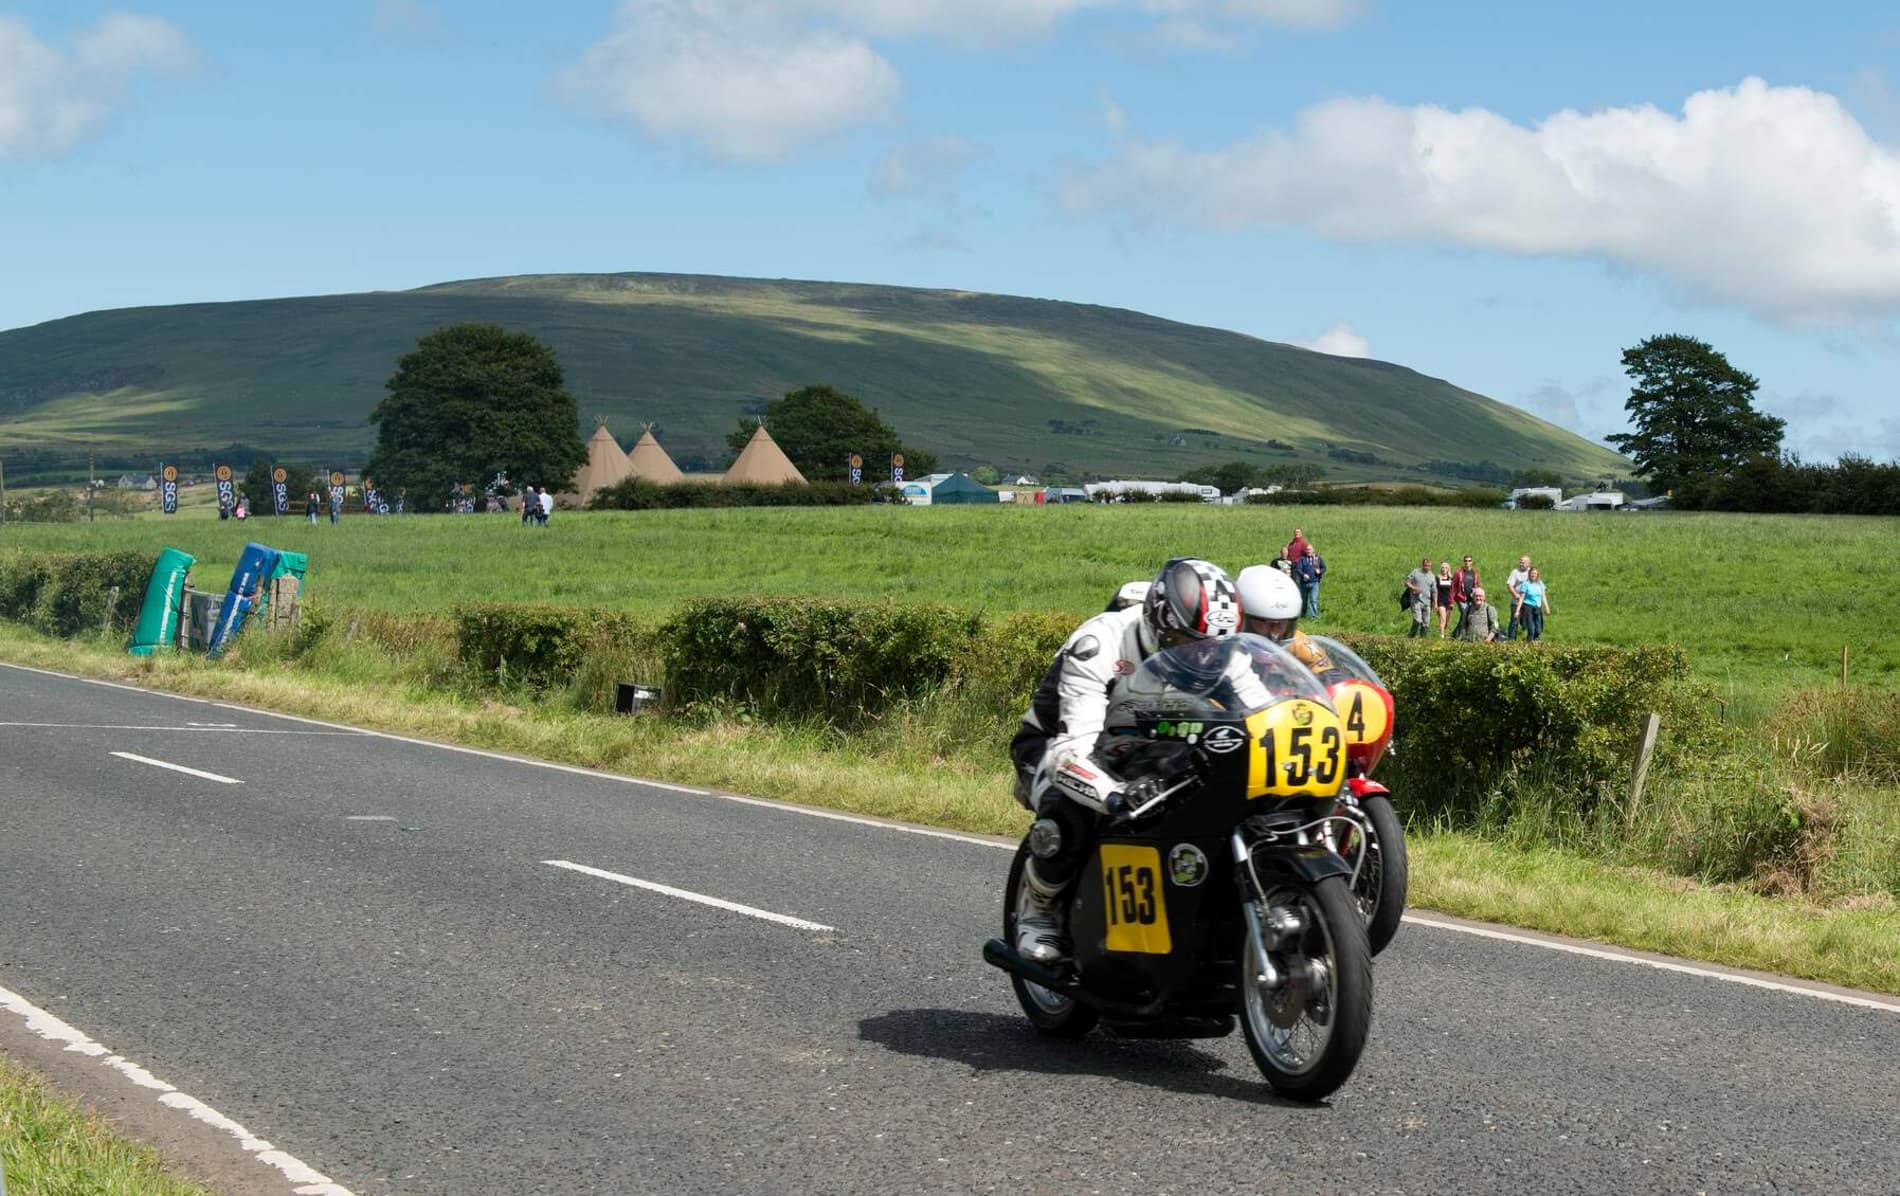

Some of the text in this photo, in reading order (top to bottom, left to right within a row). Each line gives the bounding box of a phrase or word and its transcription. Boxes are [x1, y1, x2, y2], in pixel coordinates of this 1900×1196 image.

[165, 482, 176, 511] SGS
[276, 483, 289, 511] SGS
[1347, 691, 1365, 742] 4
[1259, 726, 1341, 788] 153
[1106, 864, 1156, 926] 153
